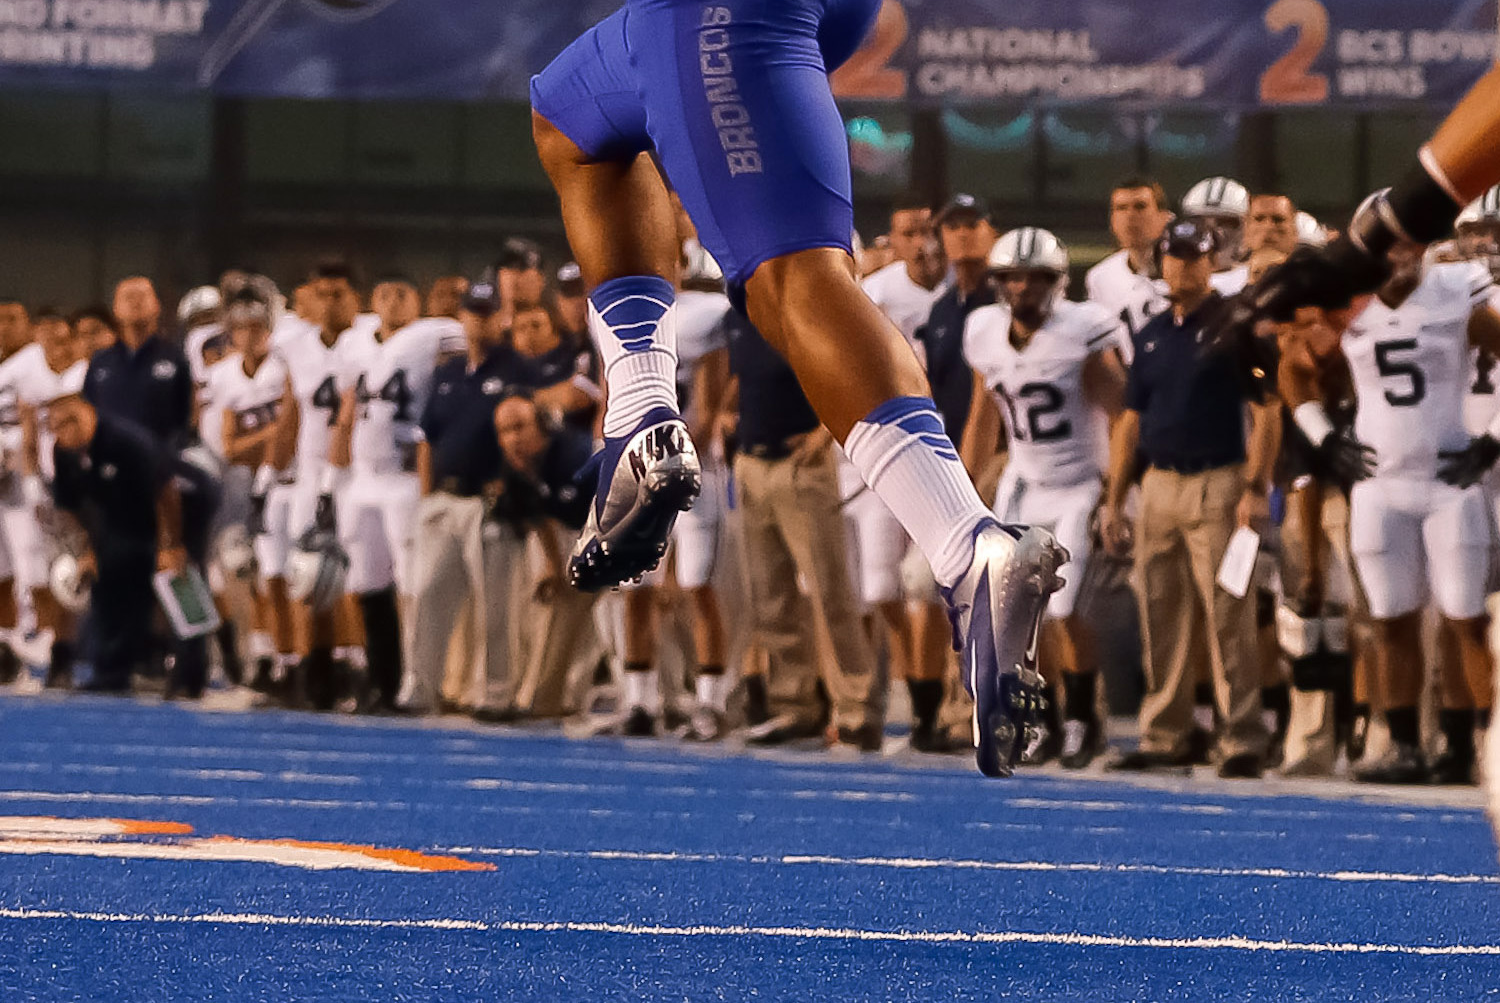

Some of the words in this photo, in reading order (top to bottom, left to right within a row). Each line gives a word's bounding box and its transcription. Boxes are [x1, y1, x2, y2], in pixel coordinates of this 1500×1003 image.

[918, 27, 1094, 62] NATIONAL
[699, 6, 764, 179] BRONCOS
[1374, 337, 1426, 407] 5
[994, 382, 1075, 442] 12
